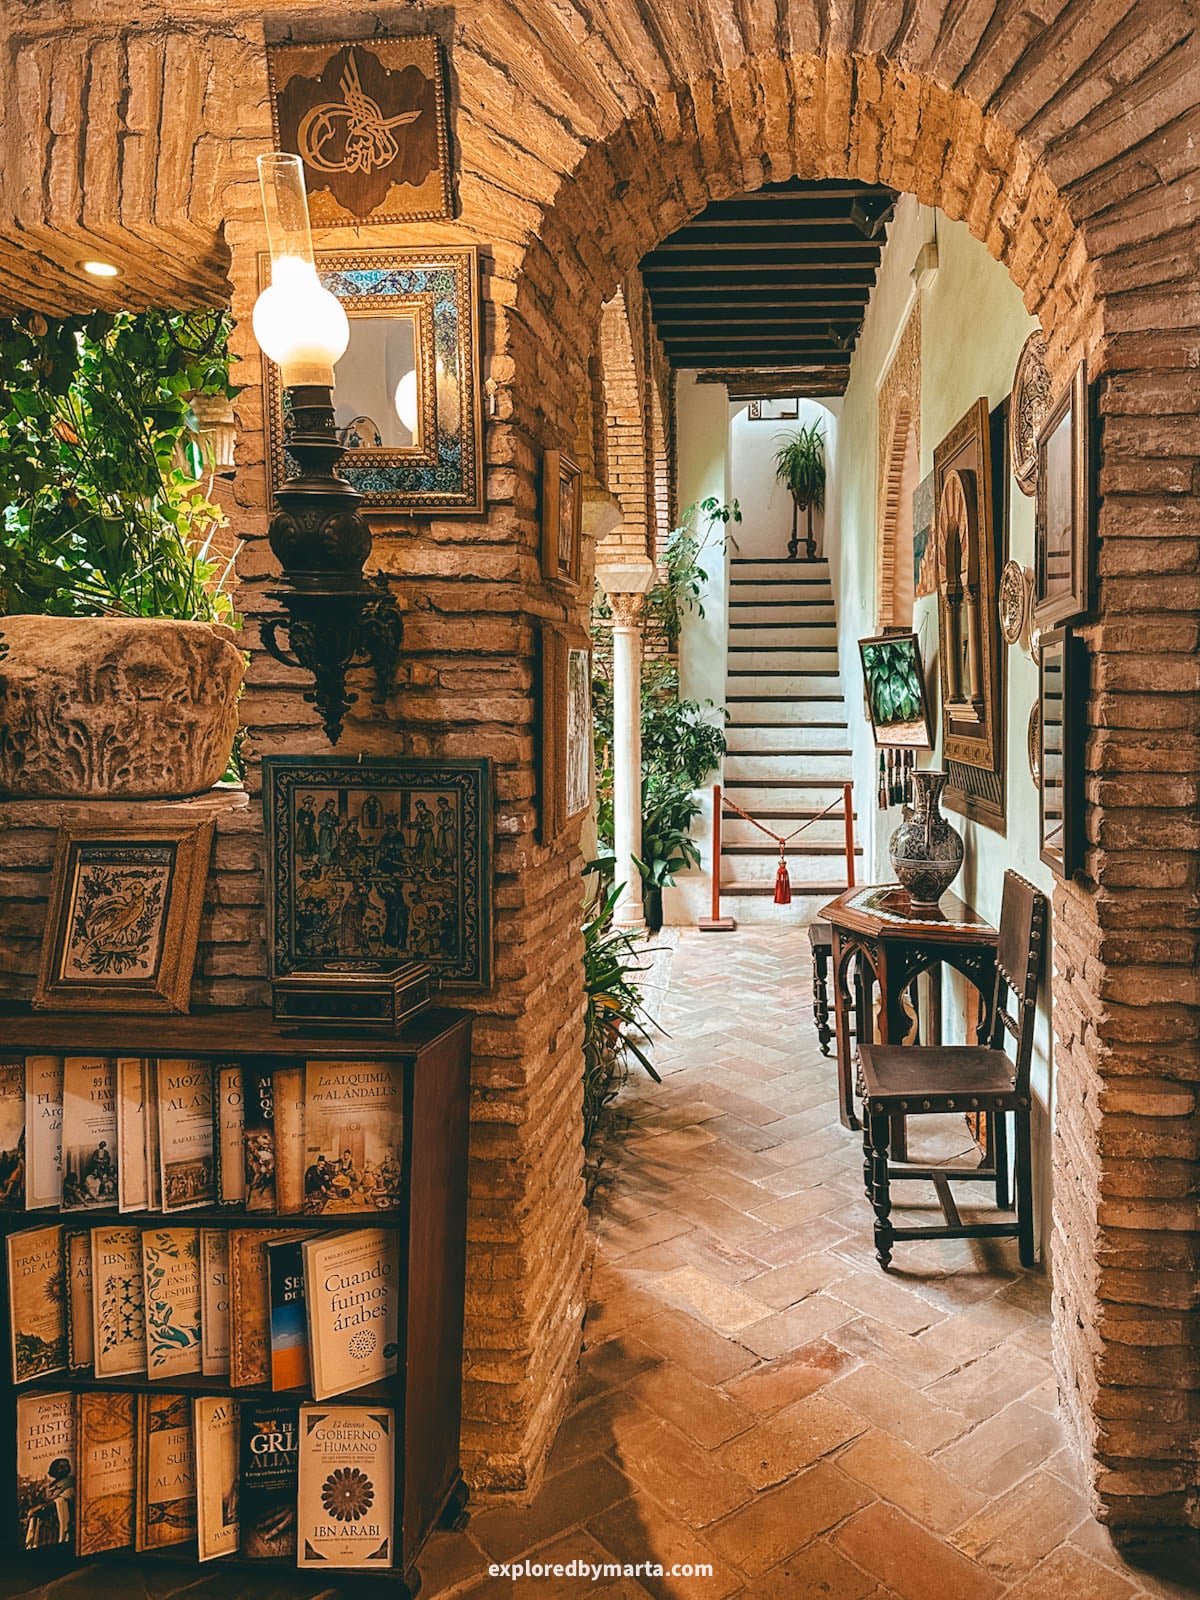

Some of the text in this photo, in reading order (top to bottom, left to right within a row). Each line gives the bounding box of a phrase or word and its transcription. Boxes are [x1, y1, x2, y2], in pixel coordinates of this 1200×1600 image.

[318, 1072, 392, 1087] La ALQUIMIA
[325, 1090, 340, 1101] AL
[343, 1087, 398, 1099] ÁNDALUS
[15, 1254, 41, 1268] TRAS
[103, 1252, 126, 1265] IBN
[325, 1261, 391, 1292] Cuando
[331, 1284, 388, 1312] fuimos
[334, 1303, 388, 1332] árabes
[29, 1418, 74, 1436] HISTO
[282, 1423, 295, 1433] EL
[316, 1429, 381, 1440] GOBIERNO
[324, 1442, 377, 1452] HUMANO
[314, 1525, 380, 1537] IBN ARABI
